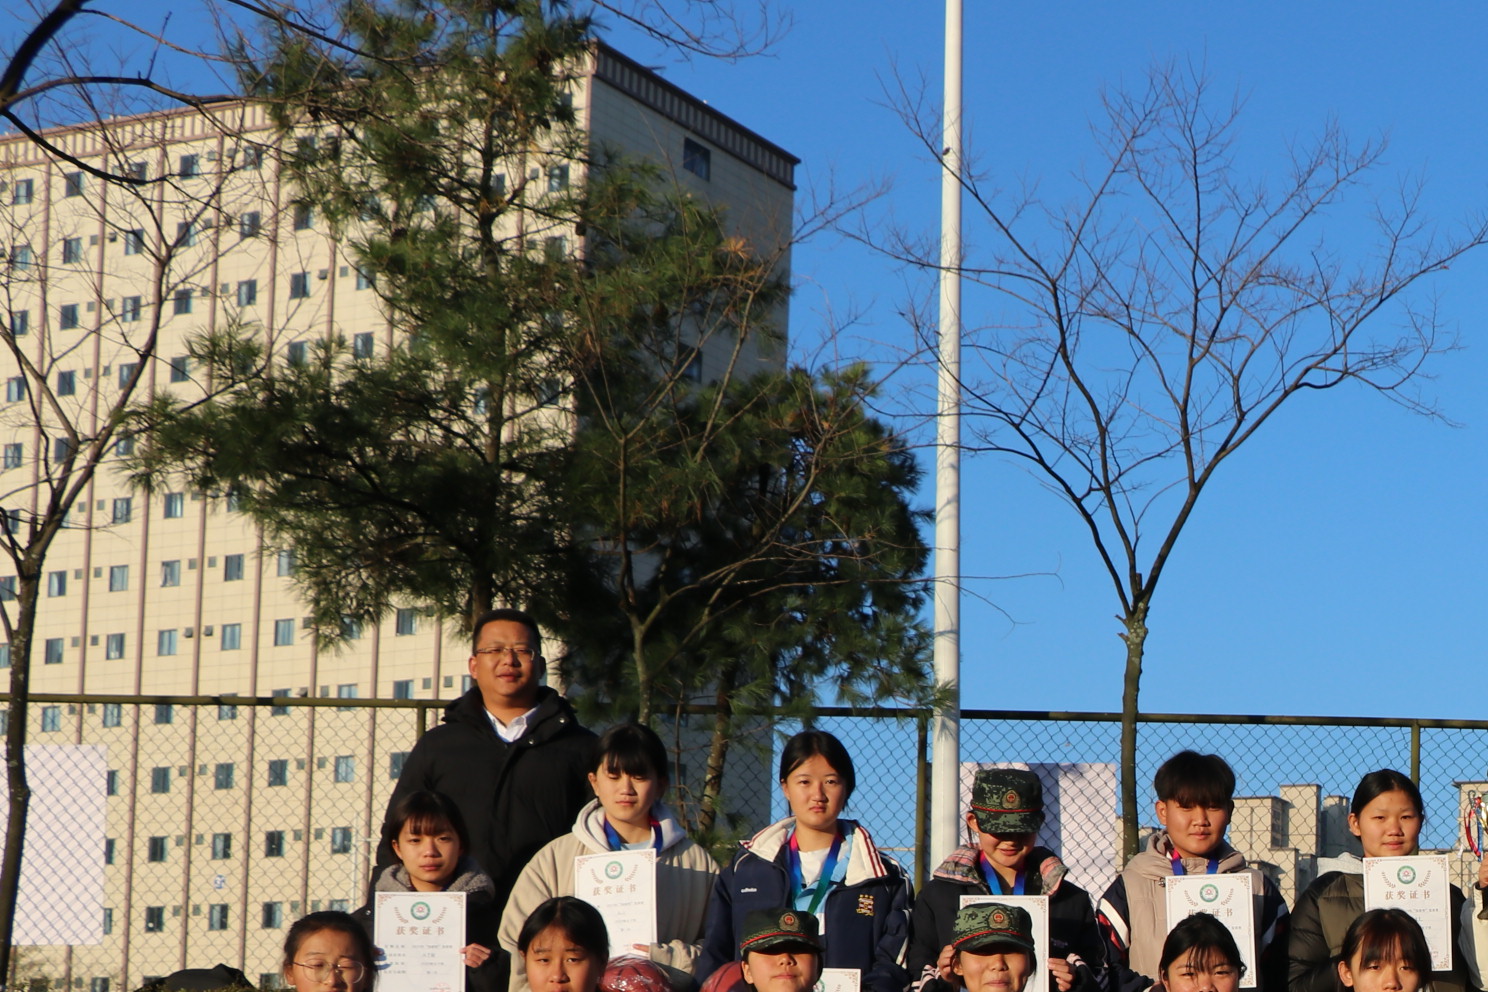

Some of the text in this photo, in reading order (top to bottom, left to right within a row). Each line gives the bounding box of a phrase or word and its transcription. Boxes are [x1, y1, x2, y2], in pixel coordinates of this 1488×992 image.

[593, 883, 636, 896] 获奖证书
[1385, 889, 1430, 900] 获奖证书
[396, 926, 445, 936] 获奖证书
